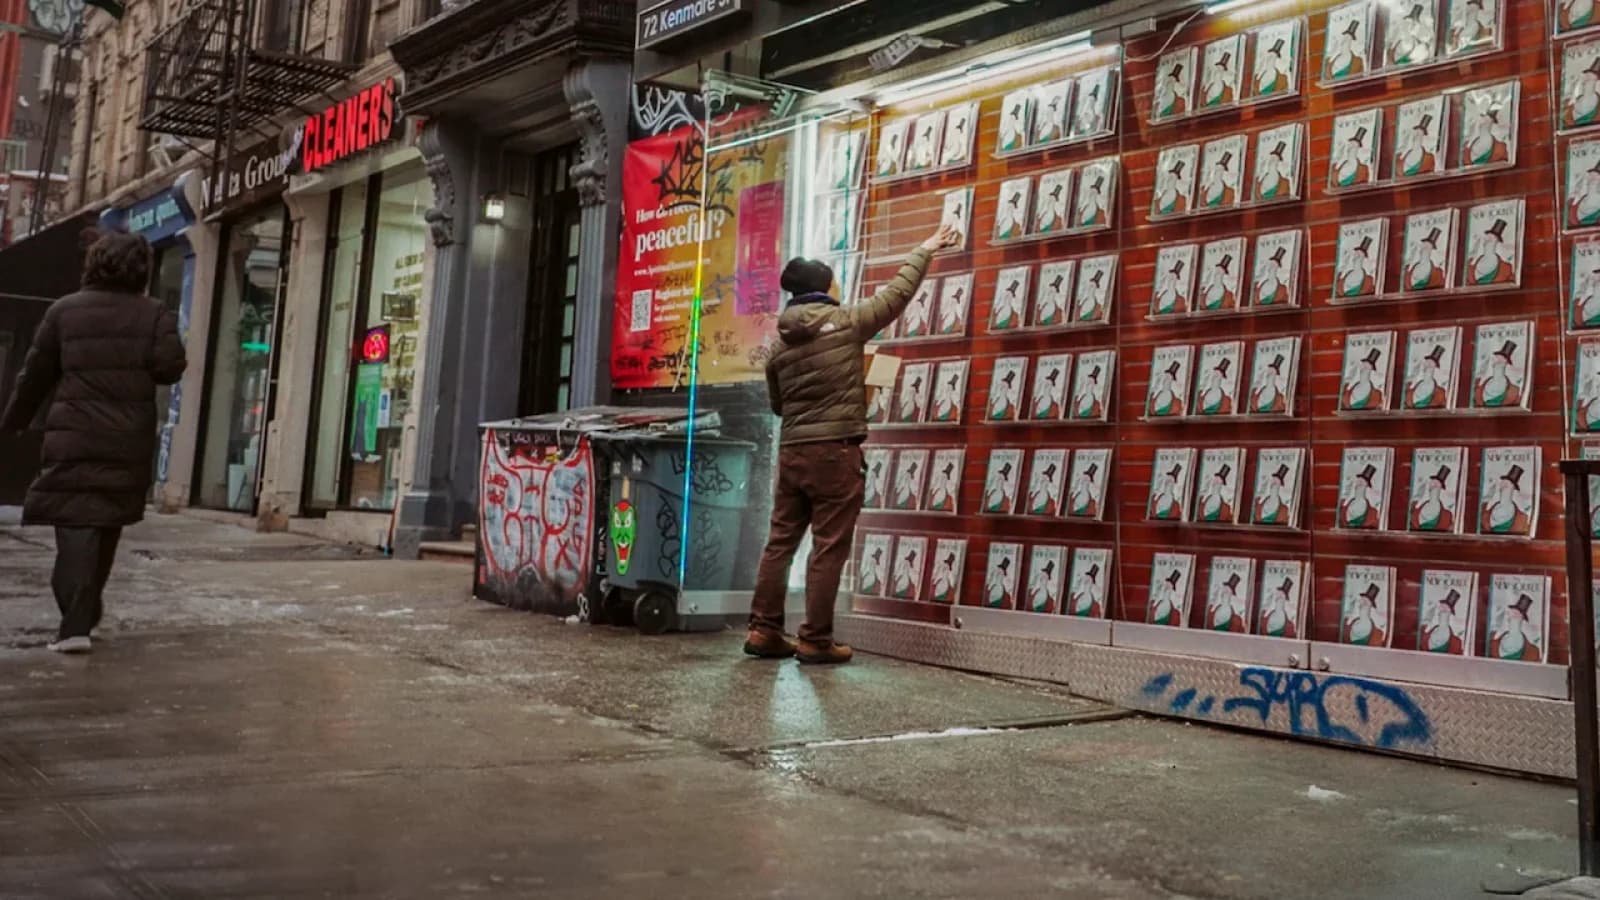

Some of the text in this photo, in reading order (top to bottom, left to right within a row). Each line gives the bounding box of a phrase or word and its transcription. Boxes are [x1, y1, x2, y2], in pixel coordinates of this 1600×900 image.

[643, 15, 658, 39] 72
[303, 76, 394, 173] CLEANERS
[634, 209, 736, 262] peaceful?
